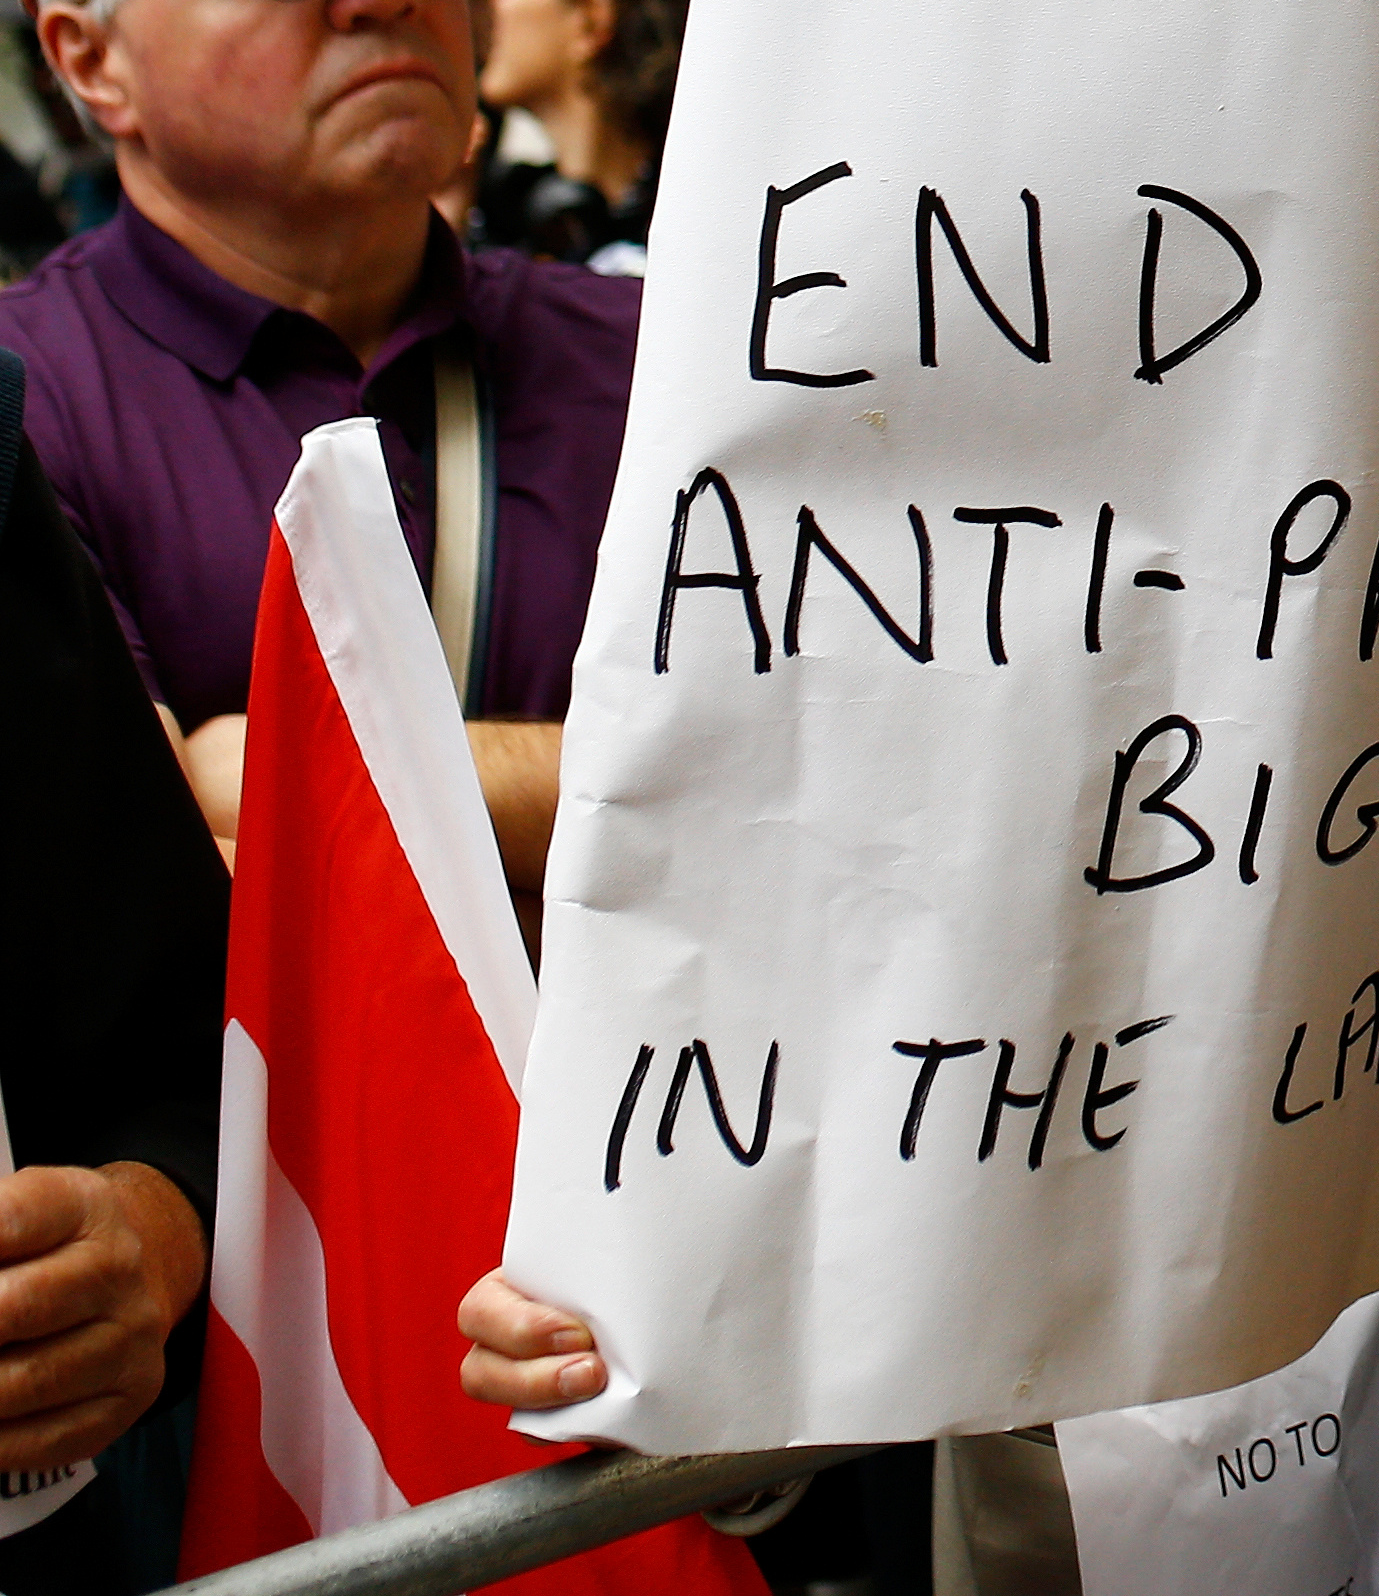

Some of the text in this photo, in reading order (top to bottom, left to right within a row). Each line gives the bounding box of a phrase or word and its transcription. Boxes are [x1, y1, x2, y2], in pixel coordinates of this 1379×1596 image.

[748, 160, 1264, 387] END
[602, 1038, 779, 1194] IN
[892, 1014, 1178, 1170] THE
[1216, 1412, 1343, 1499] NO TO
